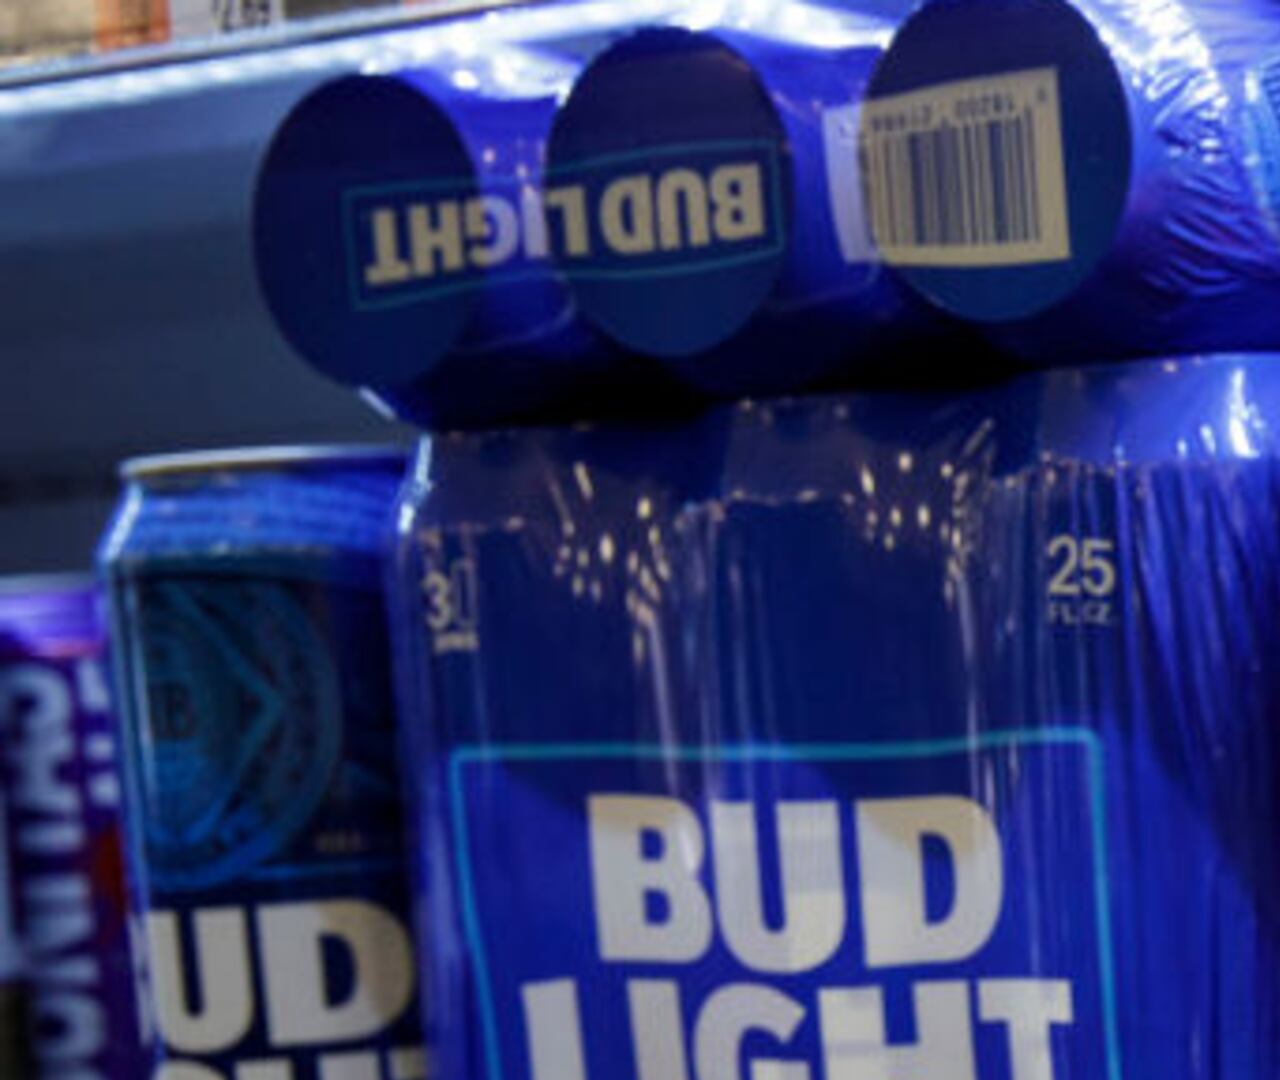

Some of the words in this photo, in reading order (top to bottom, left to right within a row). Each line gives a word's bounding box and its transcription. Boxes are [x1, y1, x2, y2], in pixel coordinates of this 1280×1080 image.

[364, 184, 589, 285] LIGHT
[600, 163, 766, 254] BUD
[422, 571, 452, 630] 3
[1046, 535, 1117, 598] 25
[587, 793, 1003, 974] BUD
